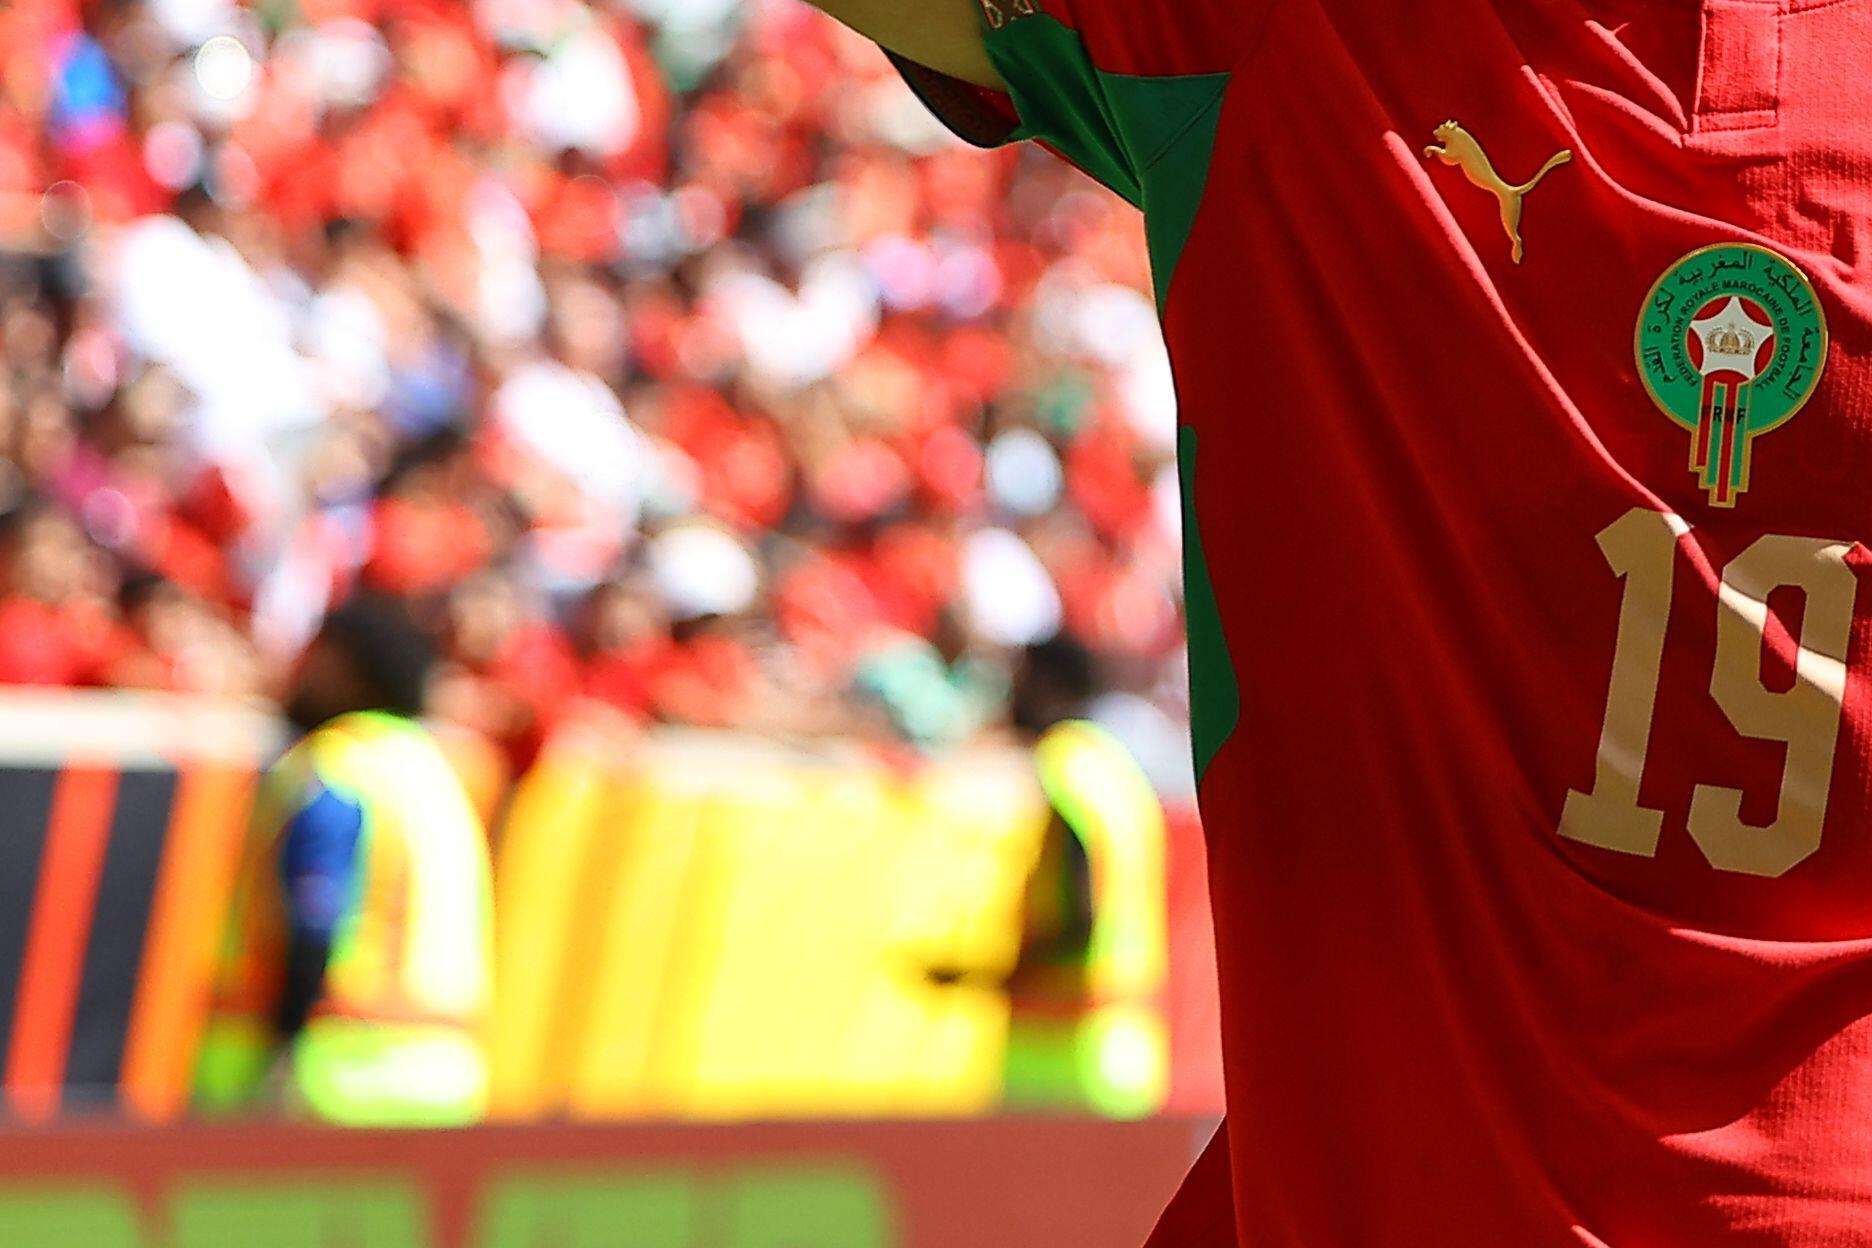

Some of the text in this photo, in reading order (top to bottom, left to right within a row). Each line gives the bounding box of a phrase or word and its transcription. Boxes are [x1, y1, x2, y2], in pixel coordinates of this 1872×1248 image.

[1644, 251, 1820, 401] الجامعة الملكية المغربية لكرة القدم
[1671, 280, 1792, 390] FEDERATION ROYALE MAROCAINE DE FOOTBALL
[1556, 506, 1858, 878] 19
